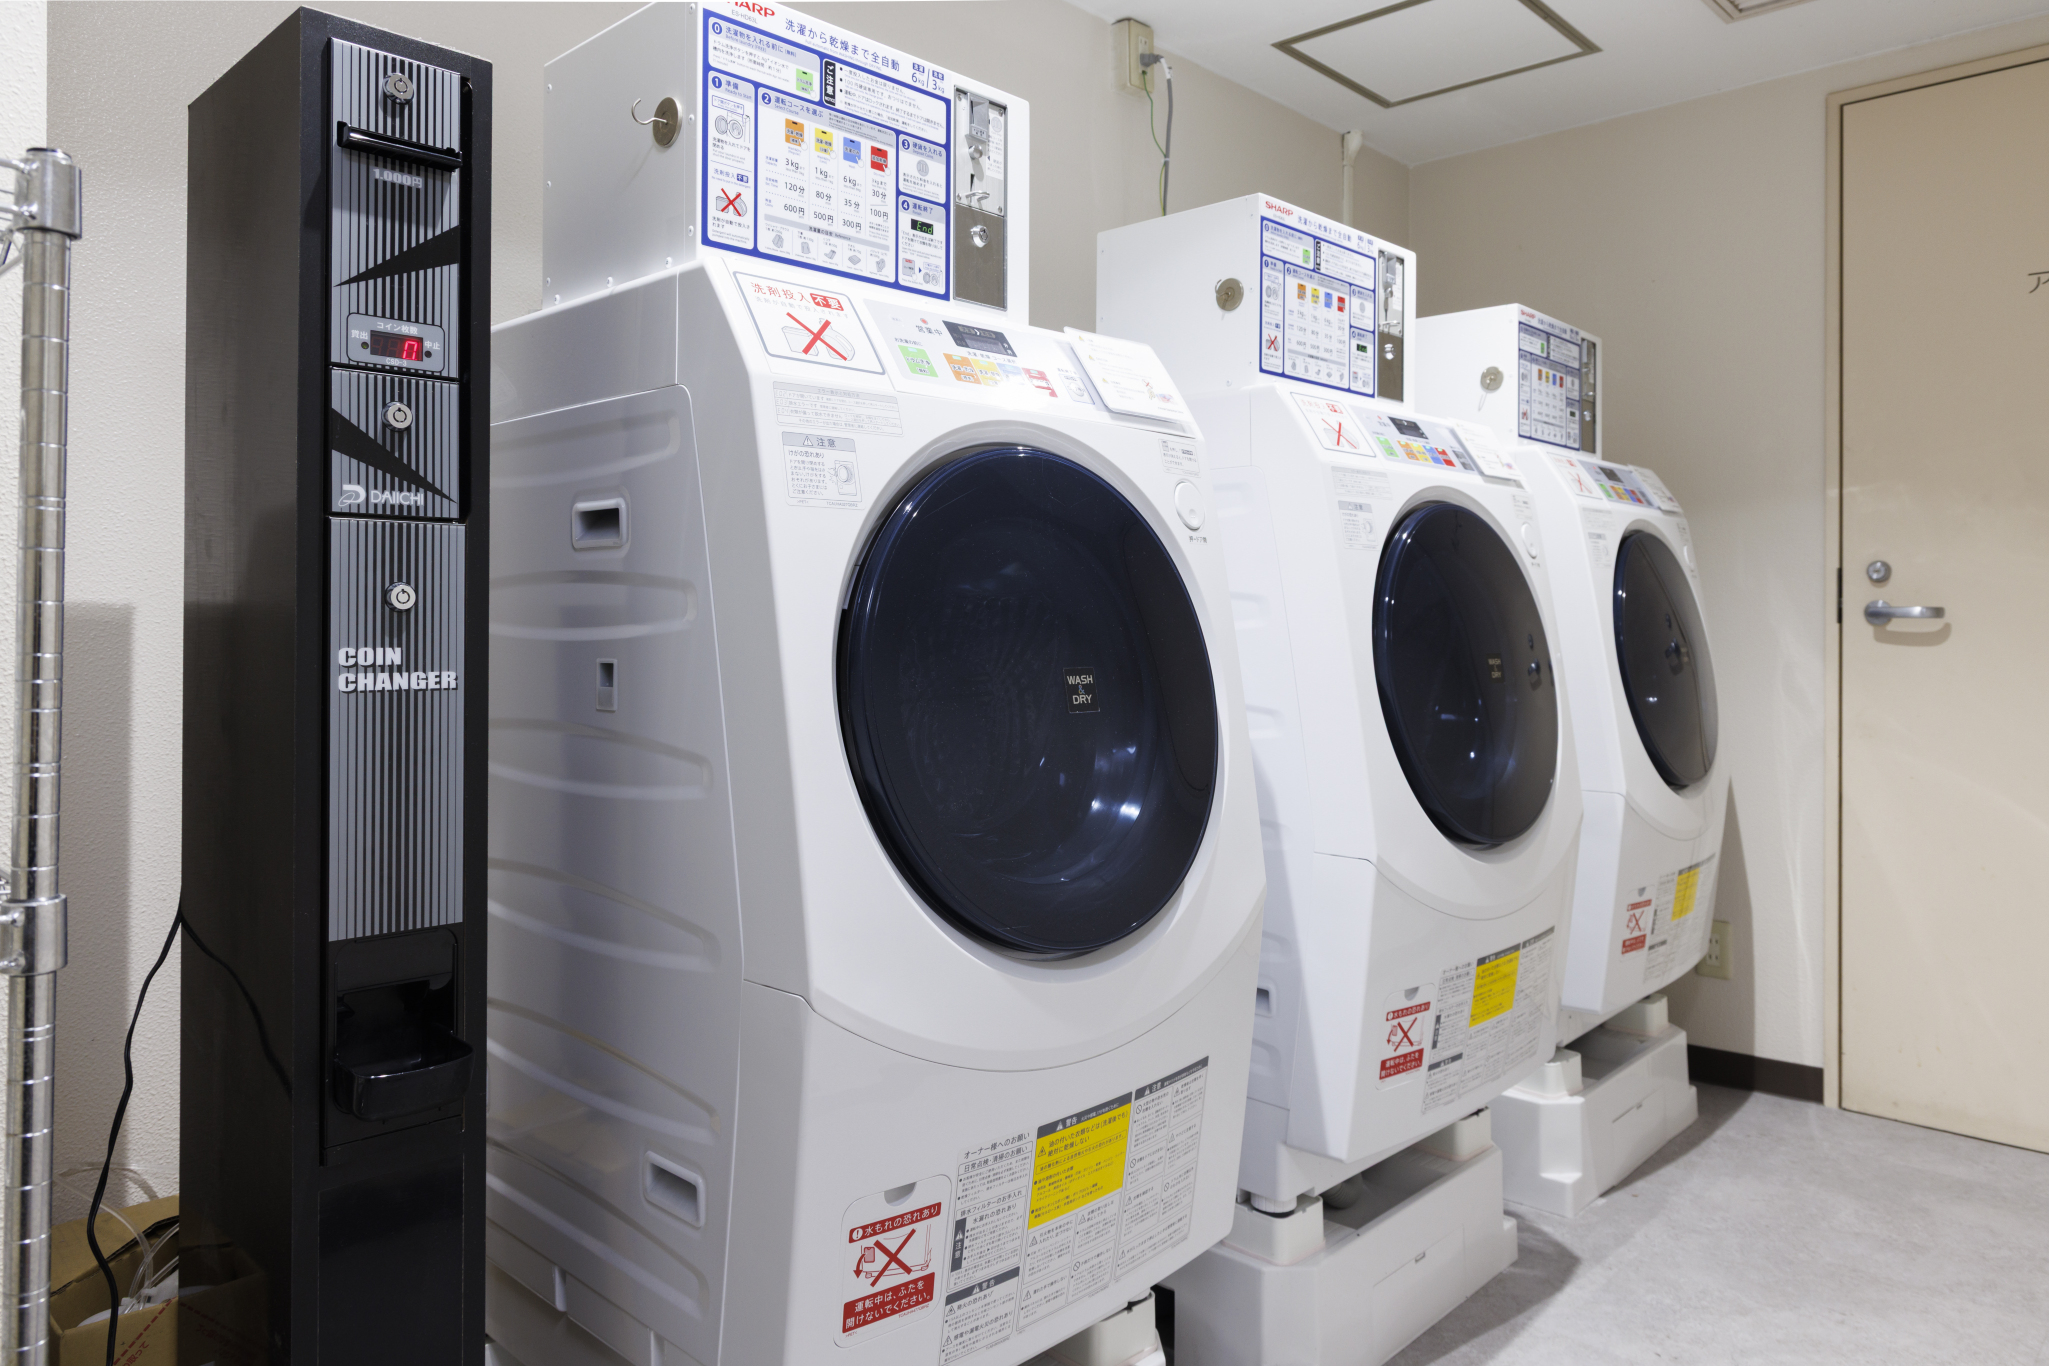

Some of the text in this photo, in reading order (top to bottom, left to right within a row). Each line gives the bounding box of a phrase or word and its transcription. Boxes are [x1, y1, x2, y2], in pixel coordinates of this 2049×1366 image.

[725, 25, 783, 53] 洗濯物を入れる前に
[785, 17, 900, 72] 洗濯から乾燥まで全自動
[725, 79, 739, 90] 準備
[774, 96, 824, 118] 運転コースを選ぶ
[912, 141, 943, 158] 硬貨を入れる
[784, 182, 805, 194] 120分
[816, 190, 832, 202] 80分
[872, 190, 887, 200] 30分
[784, 204, 805, 216] 600円
[844, 198, 860, 210] 35分
[912, 202, 933, 215] 運転終了
[1265, 200, 1294, 216] SHARP
[814, 212, 834, 224] 500円
[870, 208, 889, 220] 100円
[842, 218, 862, 231] 300円
[916, 220, 933, 234] End
[750, 282, 844, 312] 洗剤投入 不要
[376, 322, 418, 335] コイン枚数
[915, 324, 942, 336] 営業中
[424, 340, 441, 350] 中止
[386, 358, 407, 366] CSD-3
[816, 437, 837, 448] 注意
[788, 450, 825, 459] けがの恐れあり
[338, 647, 402, 667] COIN
[338, 672, 458, 692] CHANGER
[1066, 674, 1094, 684] WASH
[1078, 684, 1086, 694] &
[1072, 694, 1092, 704] DRY
[964, 1132, 1030, 1160] オーナー様へのお願い
[964, 1146, 1028, 1174] 日常点検・清掃のお願い
[864, 1204, 939, 1237] 水もれの恐れあり
[854, 1280, 925, 1314] 運転中は、ふたを
[845, 1292, 932, 1330] 開けないでください。
